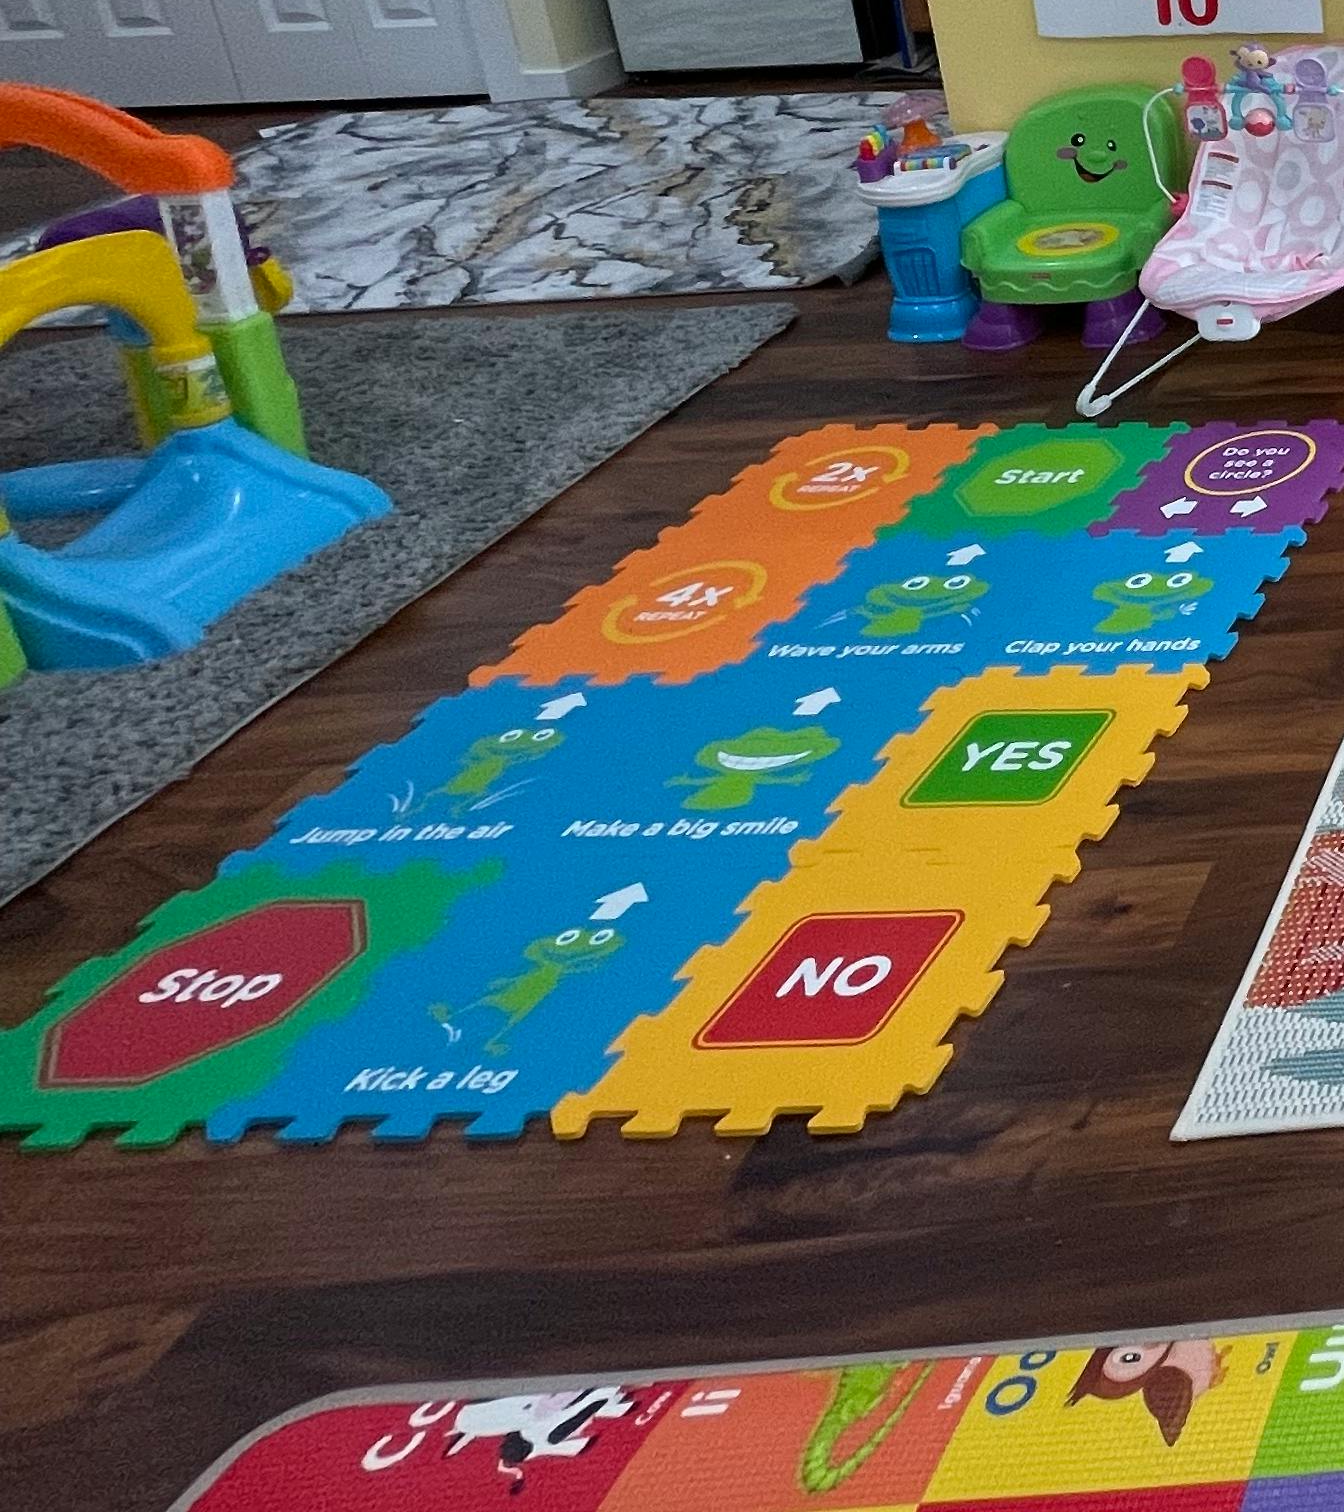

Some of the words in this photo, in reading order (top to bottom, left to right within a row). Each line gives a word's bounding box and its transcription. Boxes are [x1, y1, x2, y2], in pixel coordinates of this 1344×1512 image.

[1222, 446, 1251, 457] Do
[1254, 446, 1291, 458] you
[810, 462, 881, 483] 2x
[1208, 469, 1274, 481] circle?
[1223, 459, 1260, 469] see
[1262, 459, 1275, 468] a
[994, 468, 1086, 485] Start
[796, 484, 862, 493] REPEAT
[655, 582, 735, 607] 4x
[633, 611, 708, 622] REPEAT
[767, 644, 838, 658] Wave
[837, 643, 902, 659] your
[901, 641, 966, 656] arms
[1004, 638, 1060, 656] Clap
[1063, 640, 1127, 656] your
[1126, 637, 1202, 653] hands
[961, 741, 1072, 772] YES
[289, 826, 377, 846] Jump
[378, 824, 409, 842] in
[413, 823, 462, 841] the
[467, 822, 515, 840] air
[560, 819, 641, 838] Make
[643, 823, 662, 837] a
[667, 818, 719, 840] big
[725, 816, 800, 836] smile
[775, 955, 892, 998] NO
[138, 968, 283, 1008] Stop
[343, 1067, 428, 1093] Kick
[425, 1069, 455, 1091] a
[455, 1065, 520, 1094] leg
[985, 1350, 1057, 1416] Oo
[361, 1400, 456, 1472] Cc
